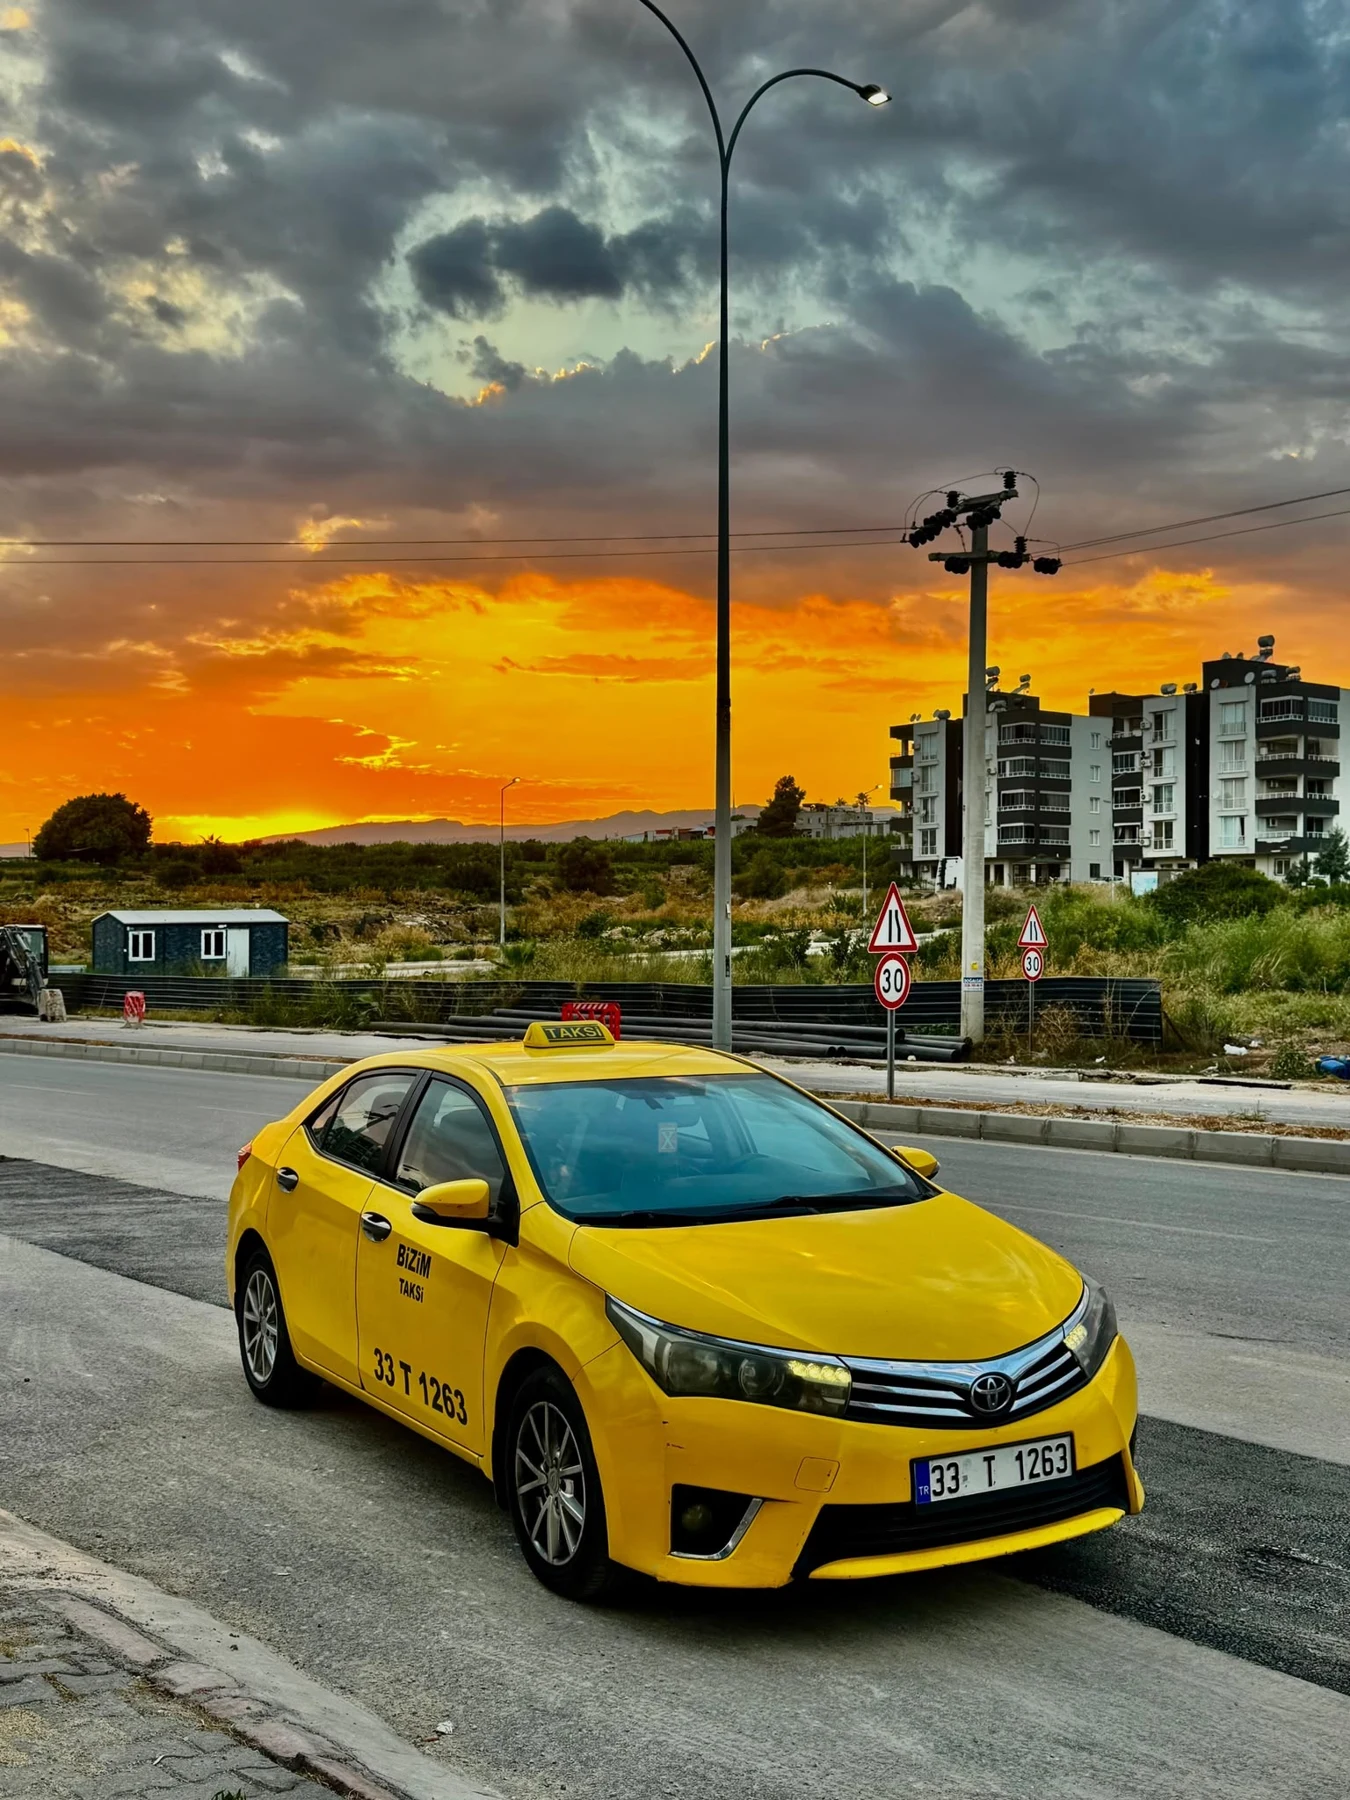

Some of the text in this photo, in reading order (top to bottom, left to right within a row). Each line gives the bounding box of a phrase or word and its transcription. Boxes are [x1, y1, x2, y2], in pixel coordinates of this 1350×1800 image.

[882, 968, 904, 993] 30
[1026, 956, 1040, 972] 30
[374, 1347, 468, 1426] 33 T 1263
[918, 1443, 1068, 1497] TR 33 T 1263
